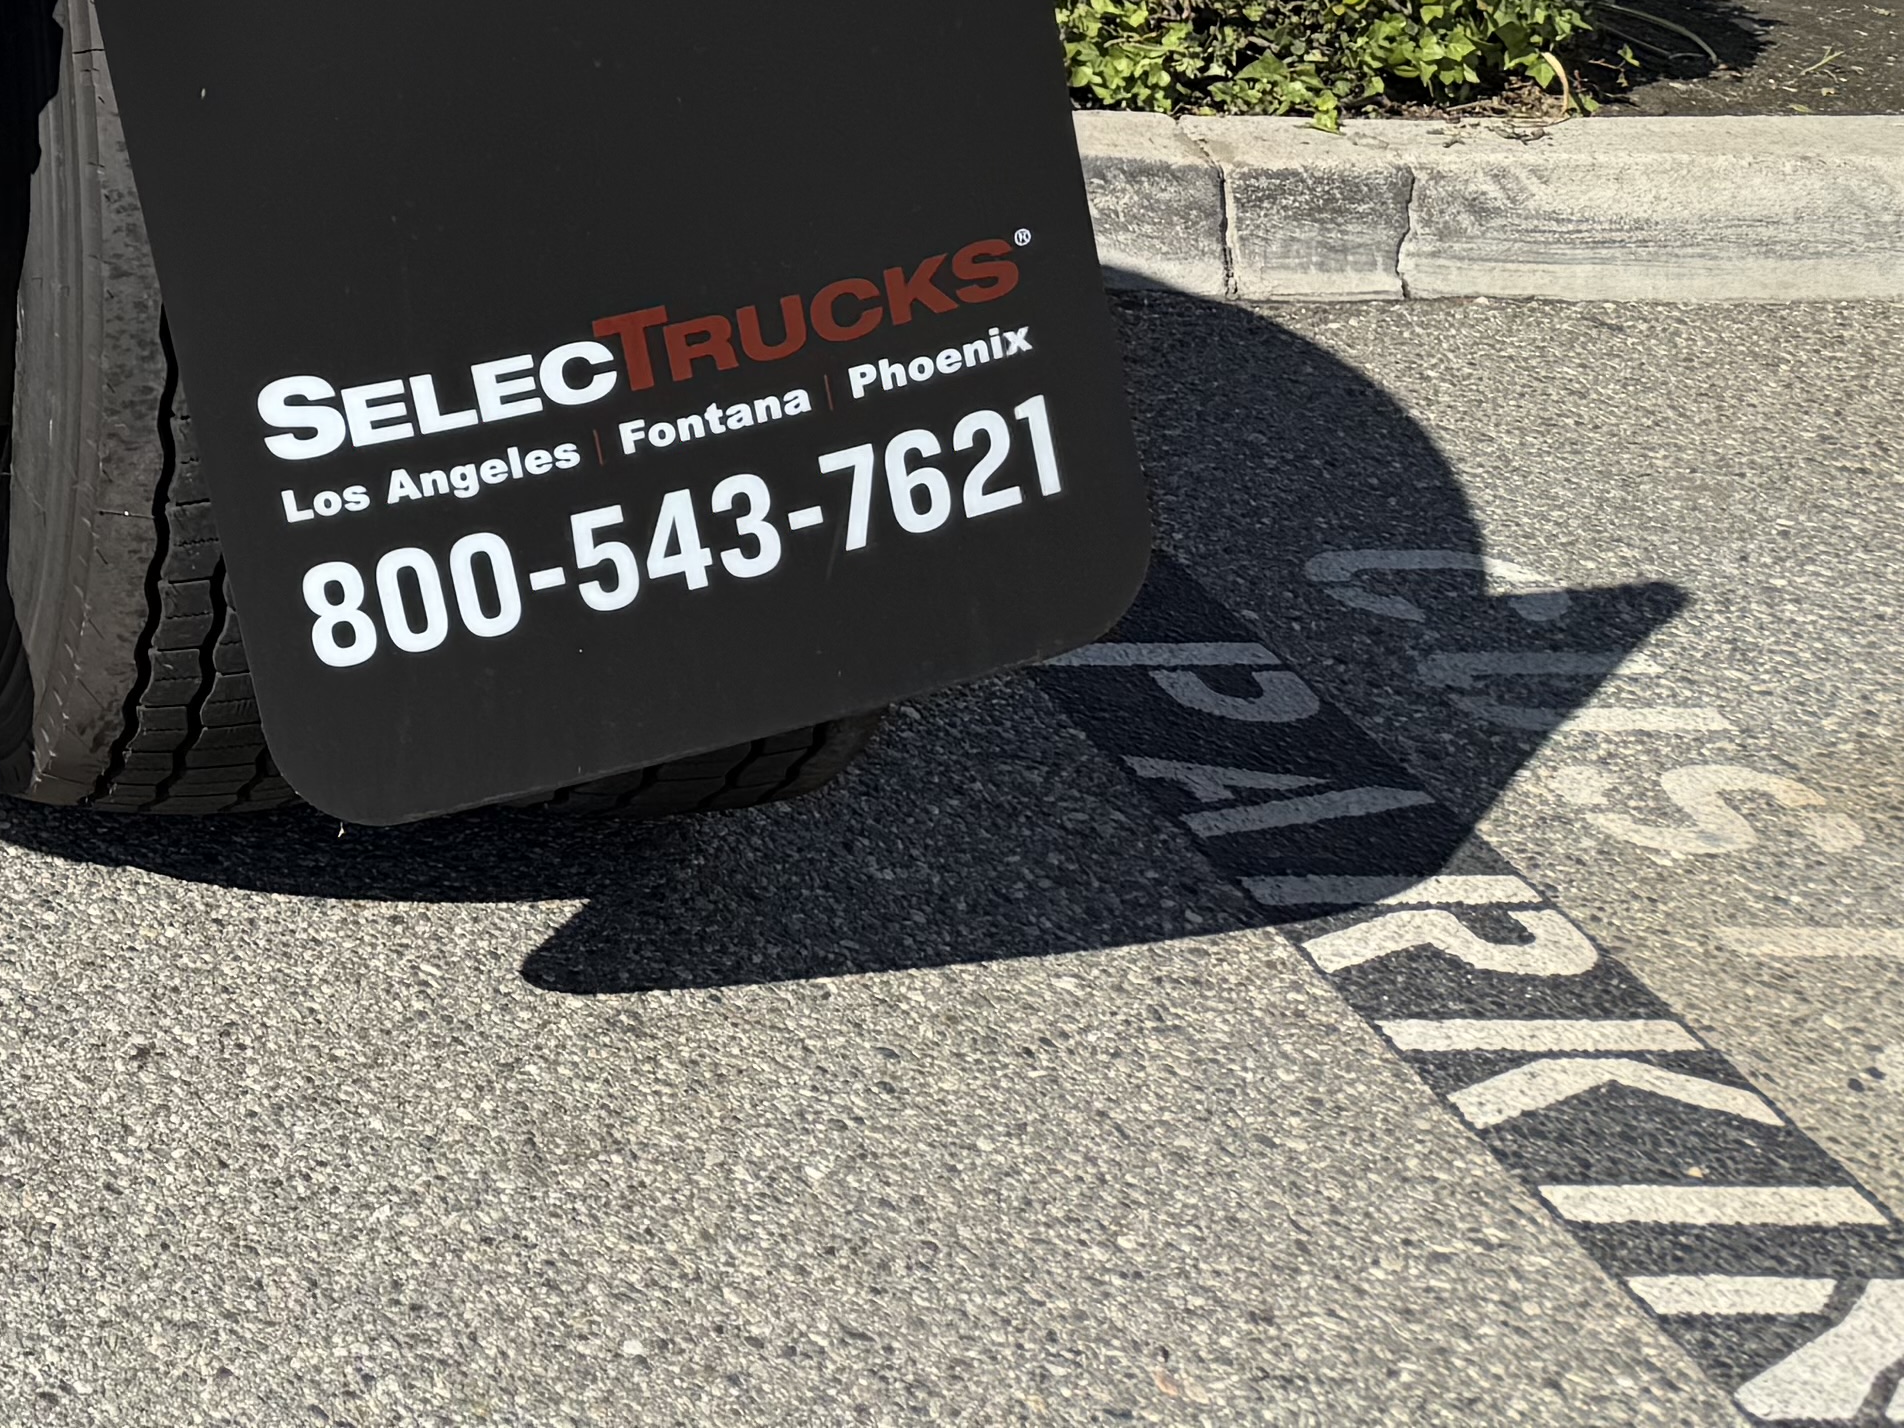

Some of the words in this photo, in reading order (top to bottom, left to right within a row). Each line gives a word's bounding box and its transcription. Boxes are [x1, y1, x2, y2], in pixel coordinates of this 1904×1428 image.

[282, 478, 371, 523] Los
[386, 435, 582, 505] Angeles
[618, 384, 813, 457] Fontana
[846, 320, 1033, 401] Phoenix
[301, 393, 1063, 670] 800-543-7621
